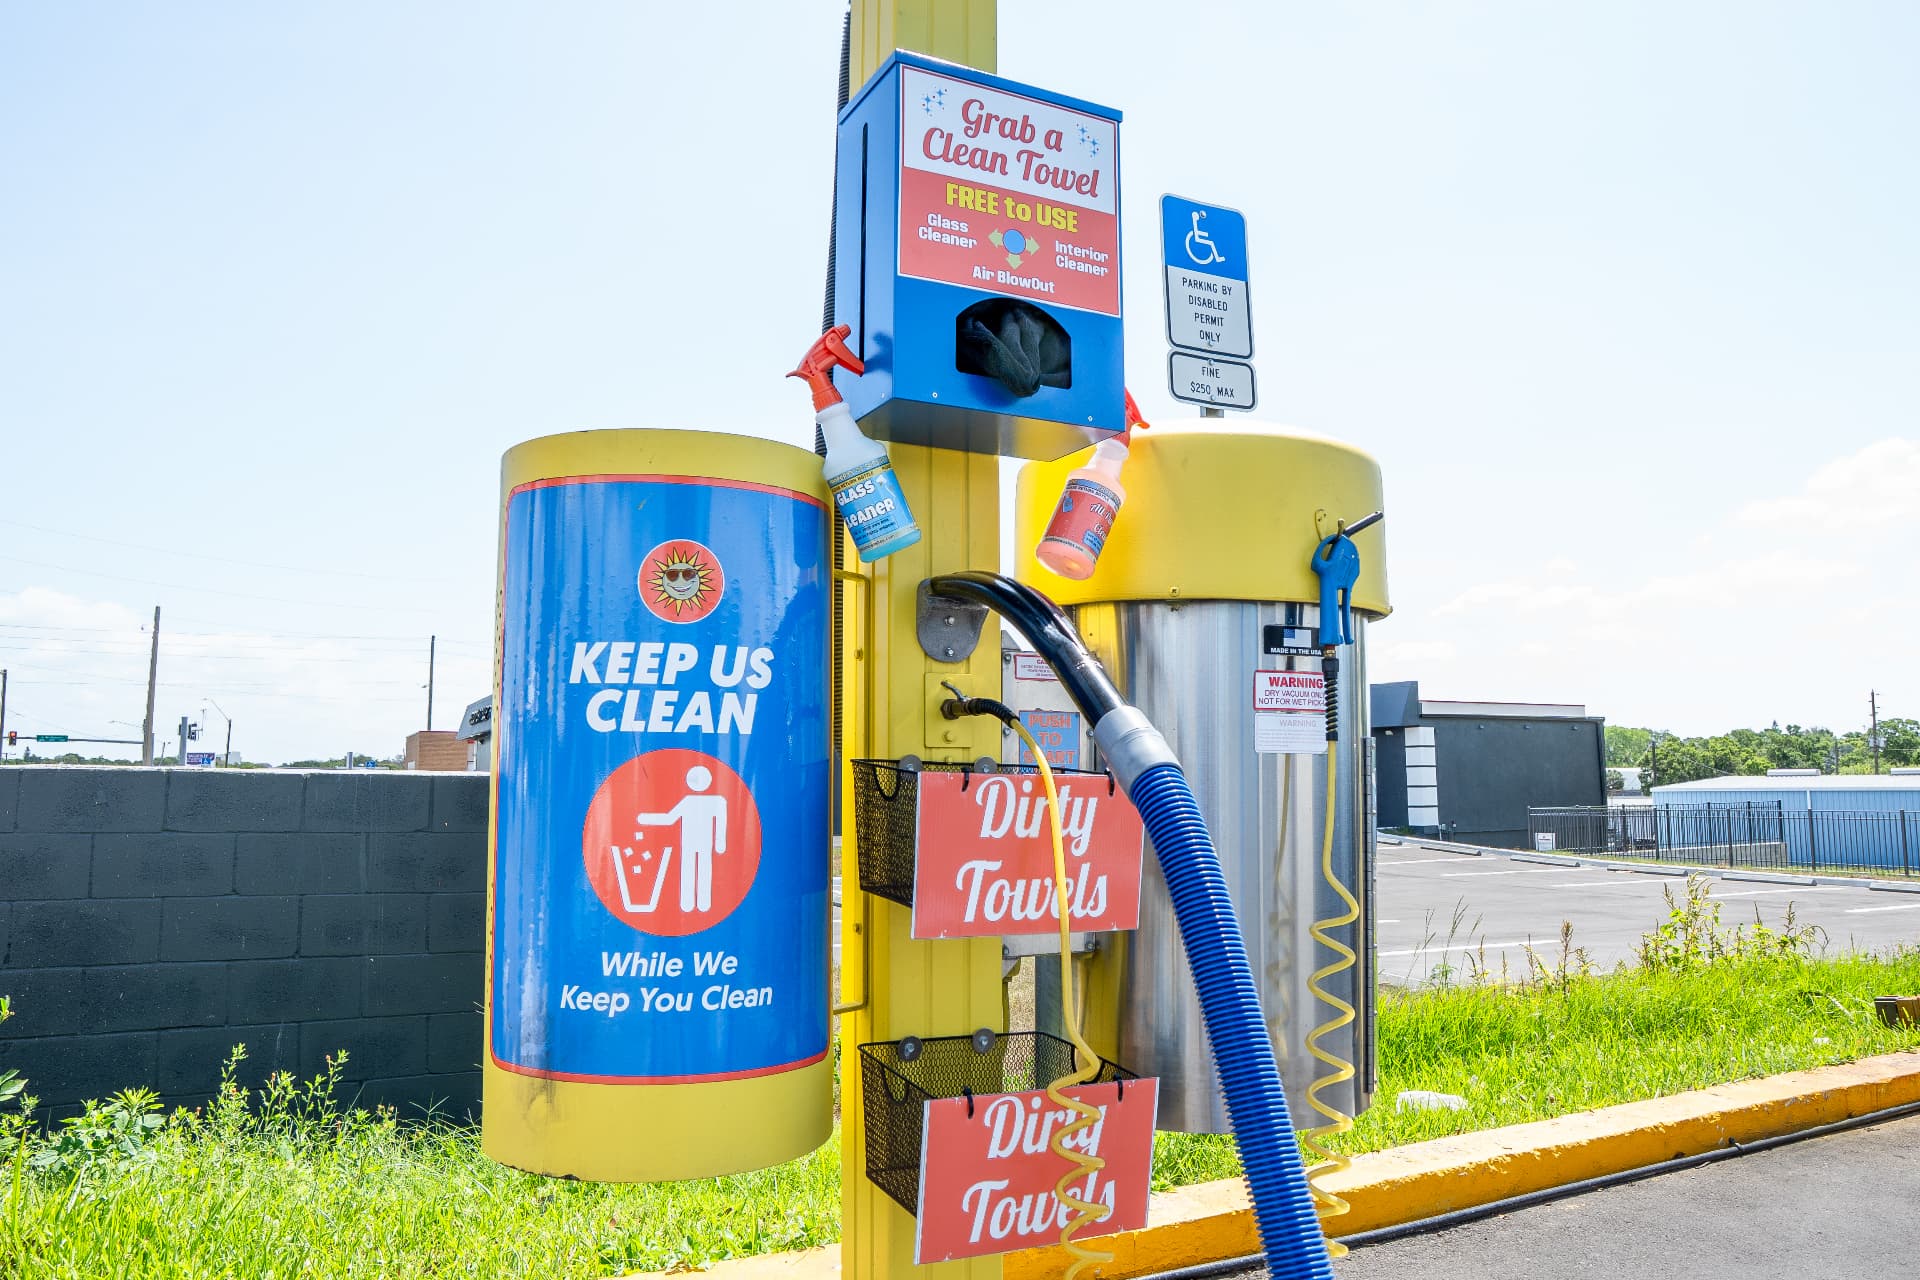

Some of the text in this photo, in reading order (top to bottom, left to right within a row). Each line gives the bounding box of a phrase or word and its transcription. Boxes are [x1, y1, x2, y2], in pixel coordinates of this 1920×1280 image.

[962, 98, 1063, 153] Grab a
[923, 127, 1100, 198] Clean Towel
[946, 182, 1079, 234] FREE to USE
[927, 213, 969, 233] Glass
[918, 226, 977, 249] Cleaner
[1056, 240, 1109, 263] Interior
[1056, 254, 1108, 277] Cleaner
[972, 265, 1056, 294] Air BlowOut
[1182, 277, 1233, 296] PARKING BY
[1188, 294, 1228, 312] DISABLED
[1194, 313, 1224, 327] PERMIT
[1200, 330, 1221, 343] ONLY
[1201, 366, 1221, 379] FINE
[1190, 380, 1235, 399] $250 MAX
[836, 479, 875, 506] GLASS
[569, 641, 775, 689] KEEP US
[1268, 676, 1324, 689] WARNING
[1258, 697, 1274, 705] NOT
[1291, 698, 1307, 706] WET
[1264, 689, 1280, 697] DRY
[1281, 690, 1310, 698] VACUUM
[585, 688, 758, 735] CLEAN
[1028, 714, 1072, 728] PUSH
[1279, 719, 1317, 728] WARNING
[1038, 731, 1062, 746] TO
[1023, 750, 1075, 764] SART
[975, 776, 1098, 857] Dirty
[956, 860, 1108, 923] Towels
[601, 950, 738, 977] While We
[560, 984, 773, 1018] Keep You Clean
